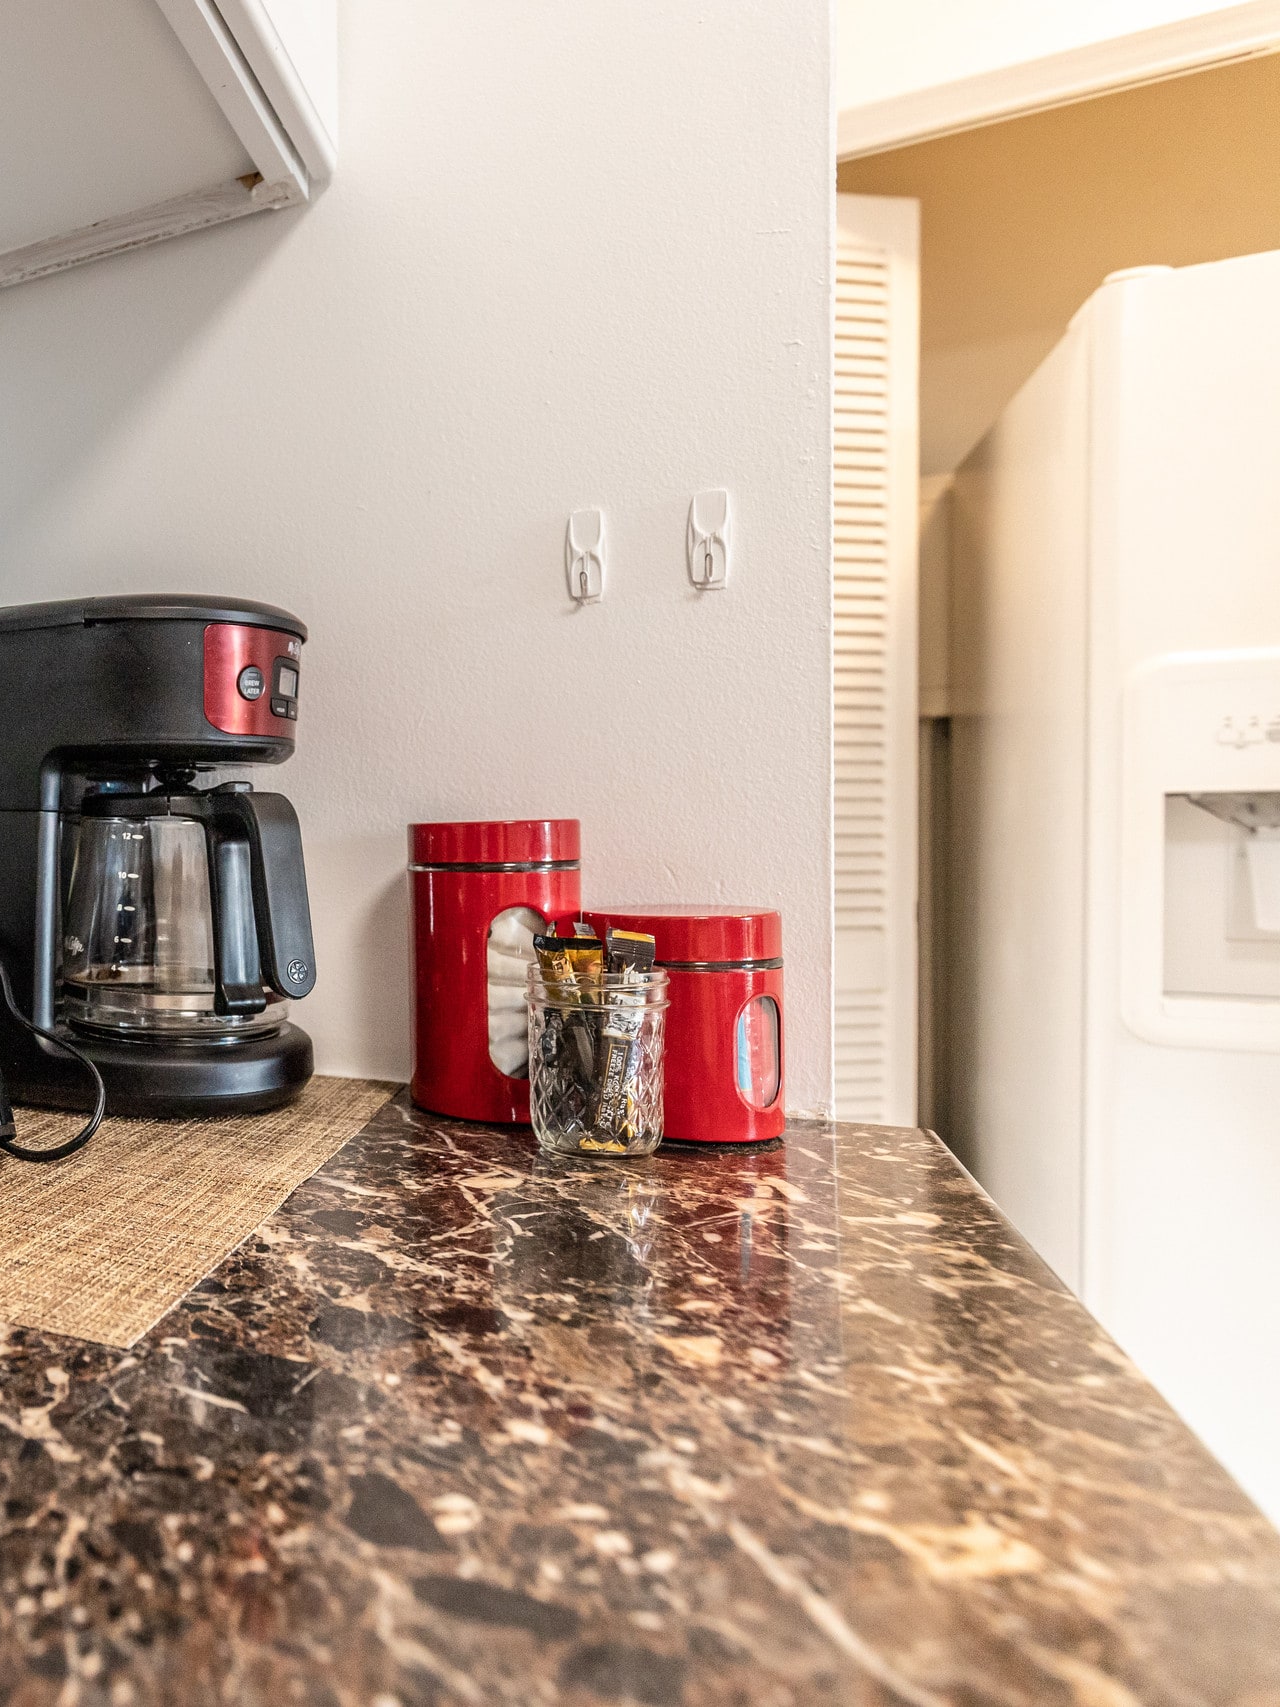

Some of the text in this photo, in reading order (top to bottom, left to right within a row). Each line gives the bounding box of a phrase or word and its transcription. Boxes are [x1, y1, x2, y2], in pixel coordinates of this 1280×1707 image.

[122, 832, 131, 840] 12
[118, 871, 127, 879] 10
[116, 903, 122, 911] 8
[113, 935, 119, 943] 6
[608, 1049, 618, 1077] FREEZE
[615, 1052, 624, 1073] 100%
